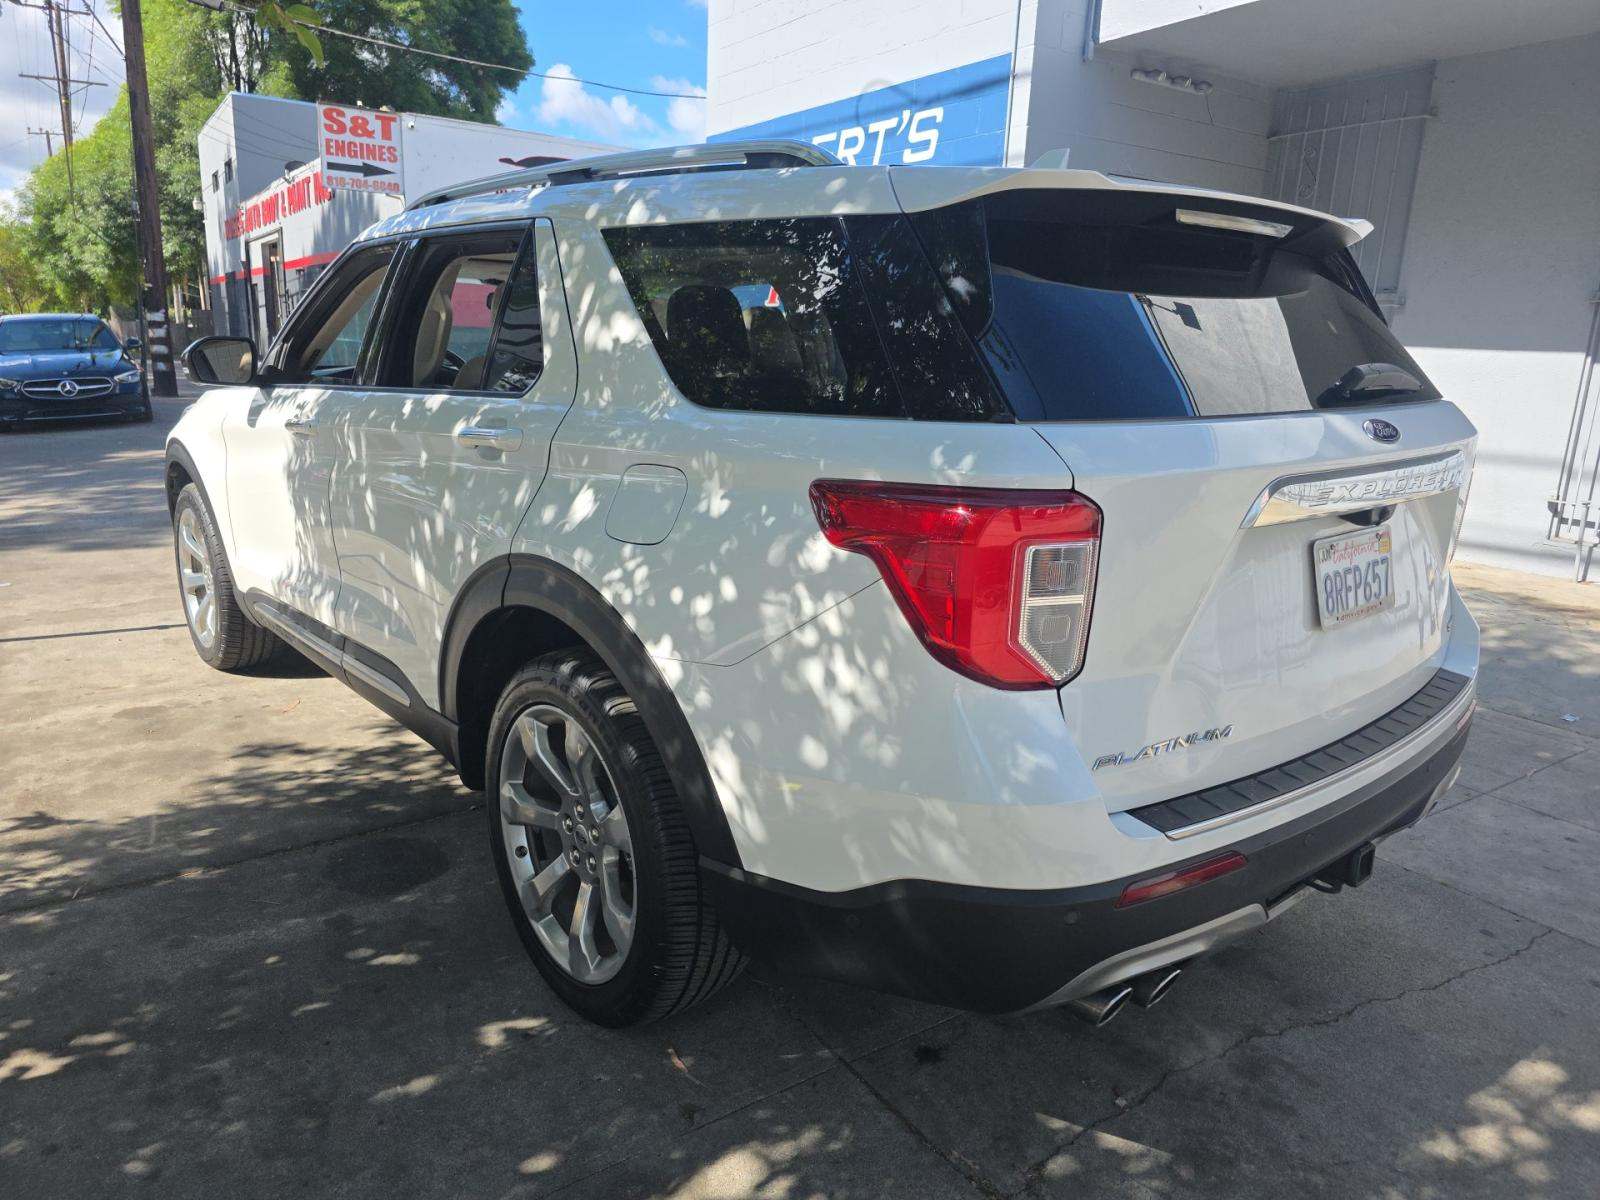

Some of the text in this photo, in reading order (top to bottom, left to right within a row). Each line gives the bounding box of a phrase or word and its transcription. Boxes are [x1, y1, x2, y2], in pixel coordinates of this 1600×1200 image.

[323, 107, 398, 141] S&T
[325, 138, 398, 163] ENGINES
[1324, 556, 1389, 616] 8RFP657
[1092, 724, 1234, 771] PLATINUM
